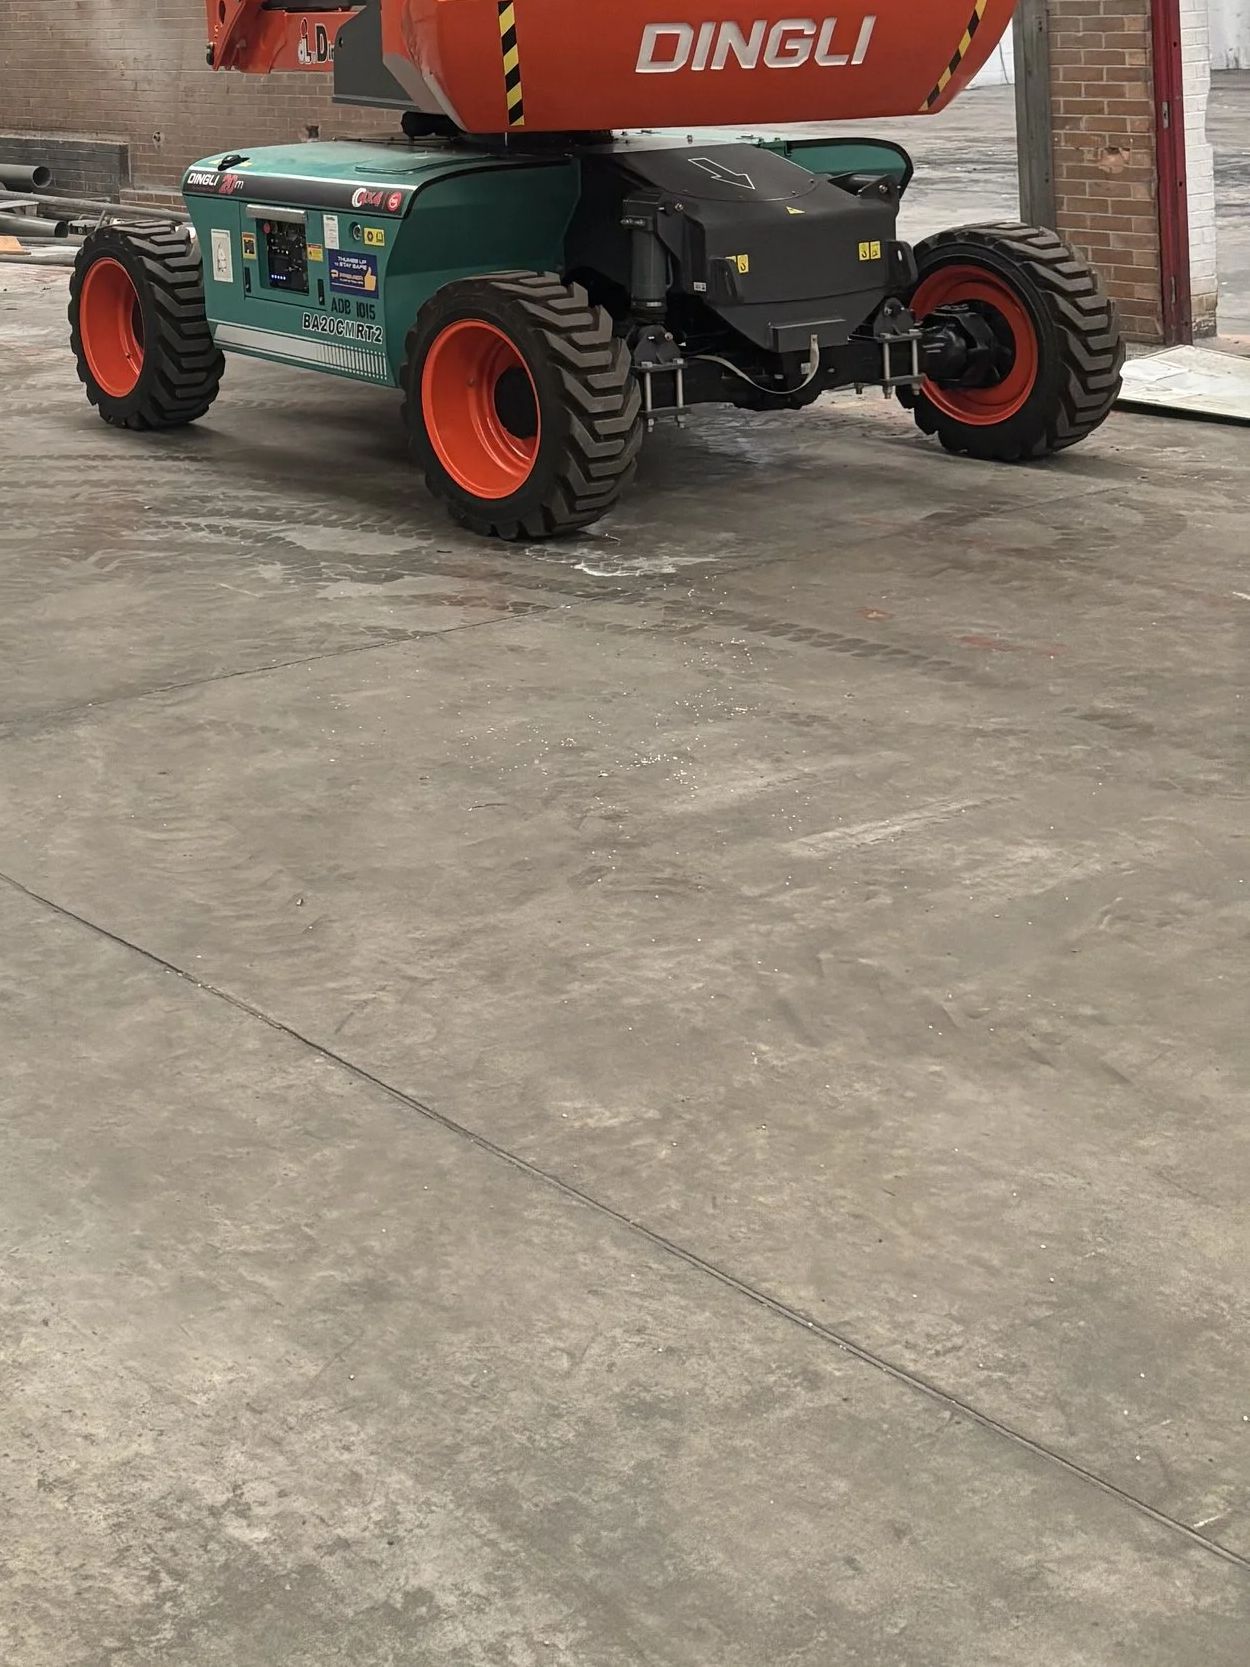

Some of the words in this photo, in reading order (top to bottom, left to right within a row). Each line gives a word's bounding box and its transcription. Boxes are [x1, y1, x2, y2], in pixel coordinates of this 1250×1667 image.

[634, 15, 877, 74] DINGLI
[187, 173, 220, 187] DINGLI
[302, 312, 384, 345] BA20CMRT2
